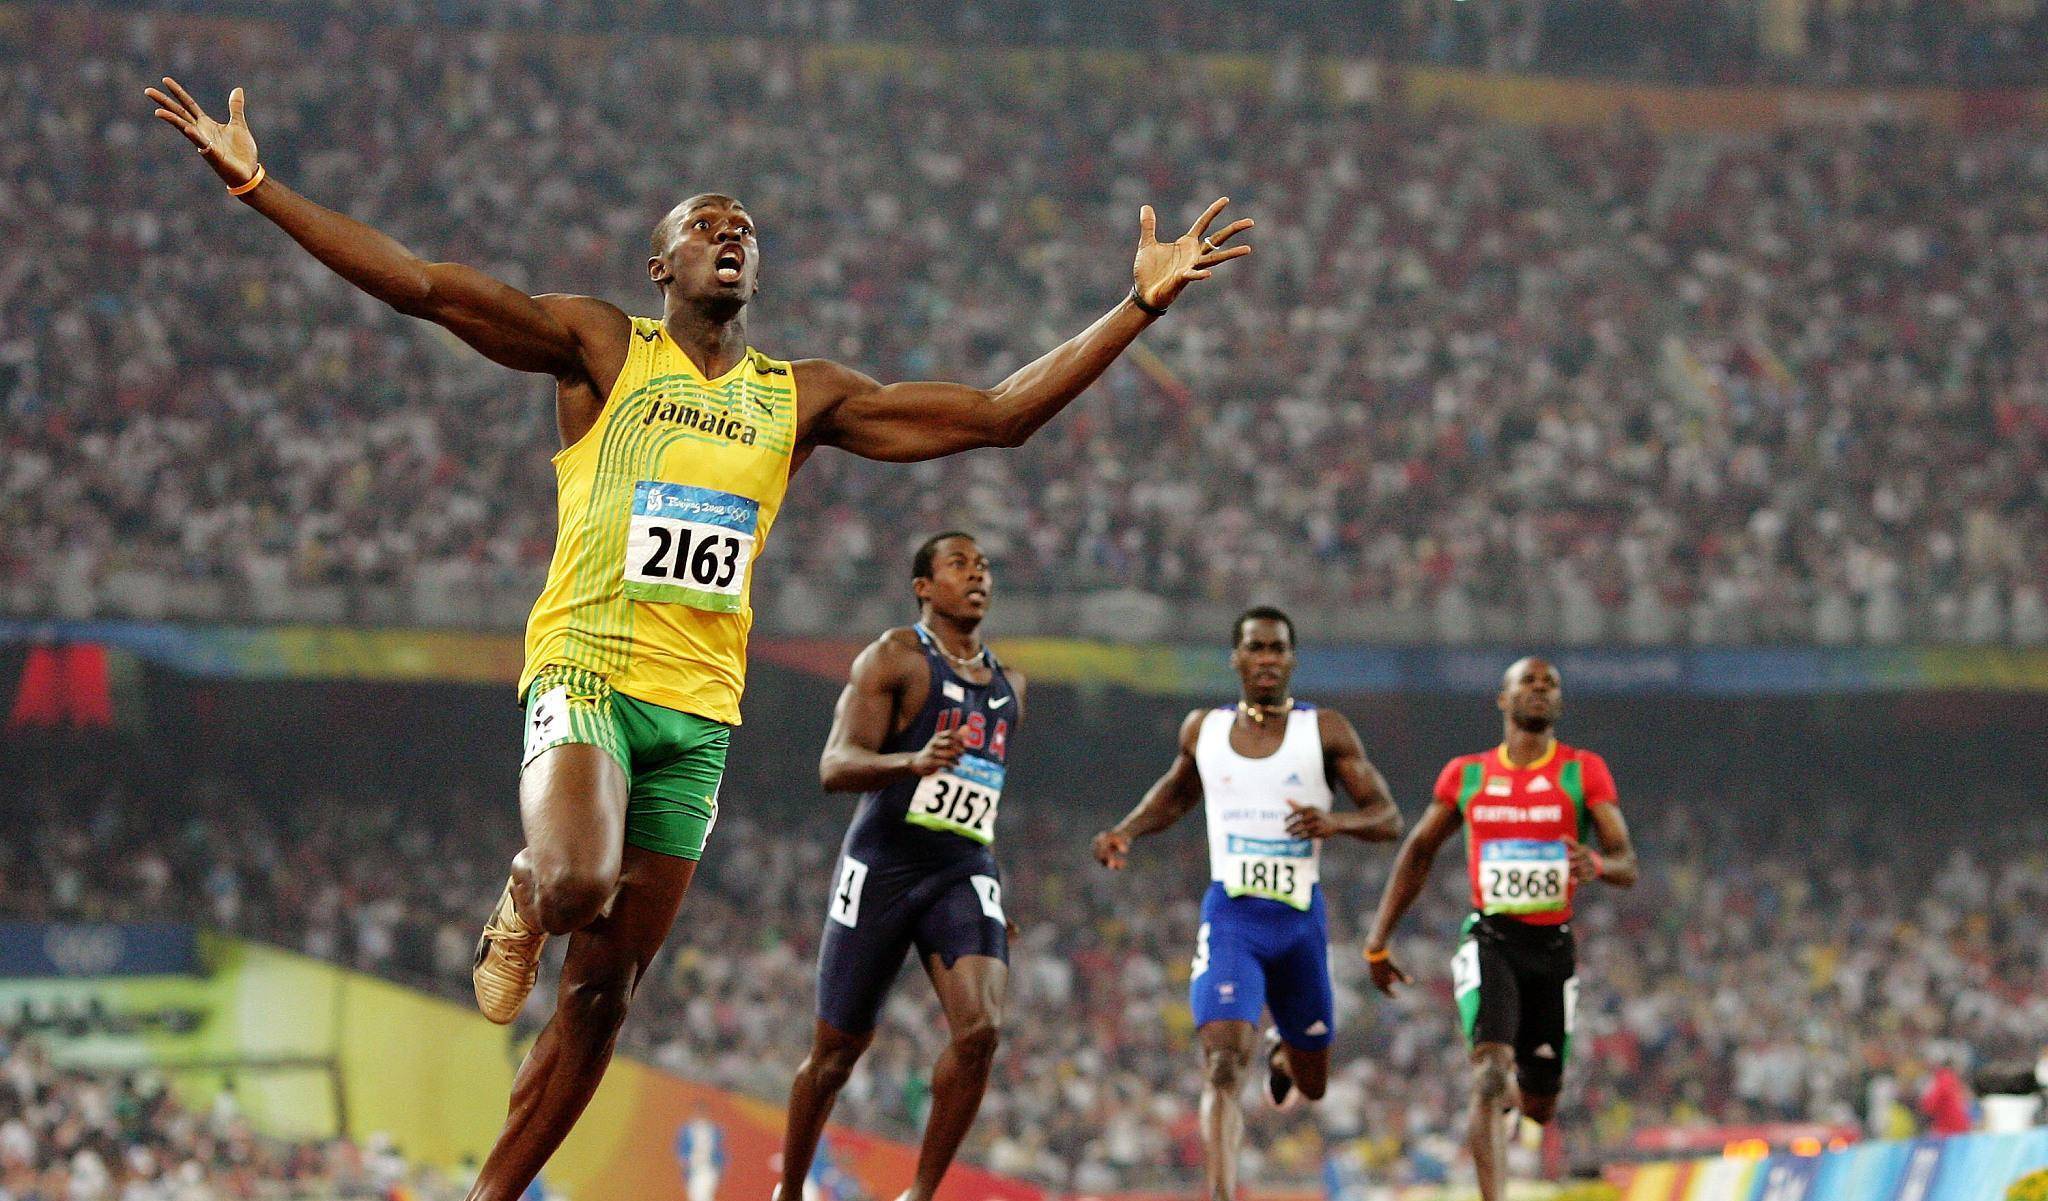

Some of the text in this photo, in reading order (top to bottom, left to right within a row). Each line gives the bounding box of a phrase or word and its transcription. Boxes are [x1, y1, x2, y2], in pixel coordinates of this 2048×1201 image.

[643, 393, 757, 446] jamaica
[665, 496, 725, 515] Beijing 2008
[641, 526, 740, 587] 2163
[935, 707, 1008, 760] USA
[925, 780, 991, 829] 3152
[841, 870, 855, 914] 4
[1242, 862, 1295, 894] 1813
[1490, 869, 1560, 897] 2868
